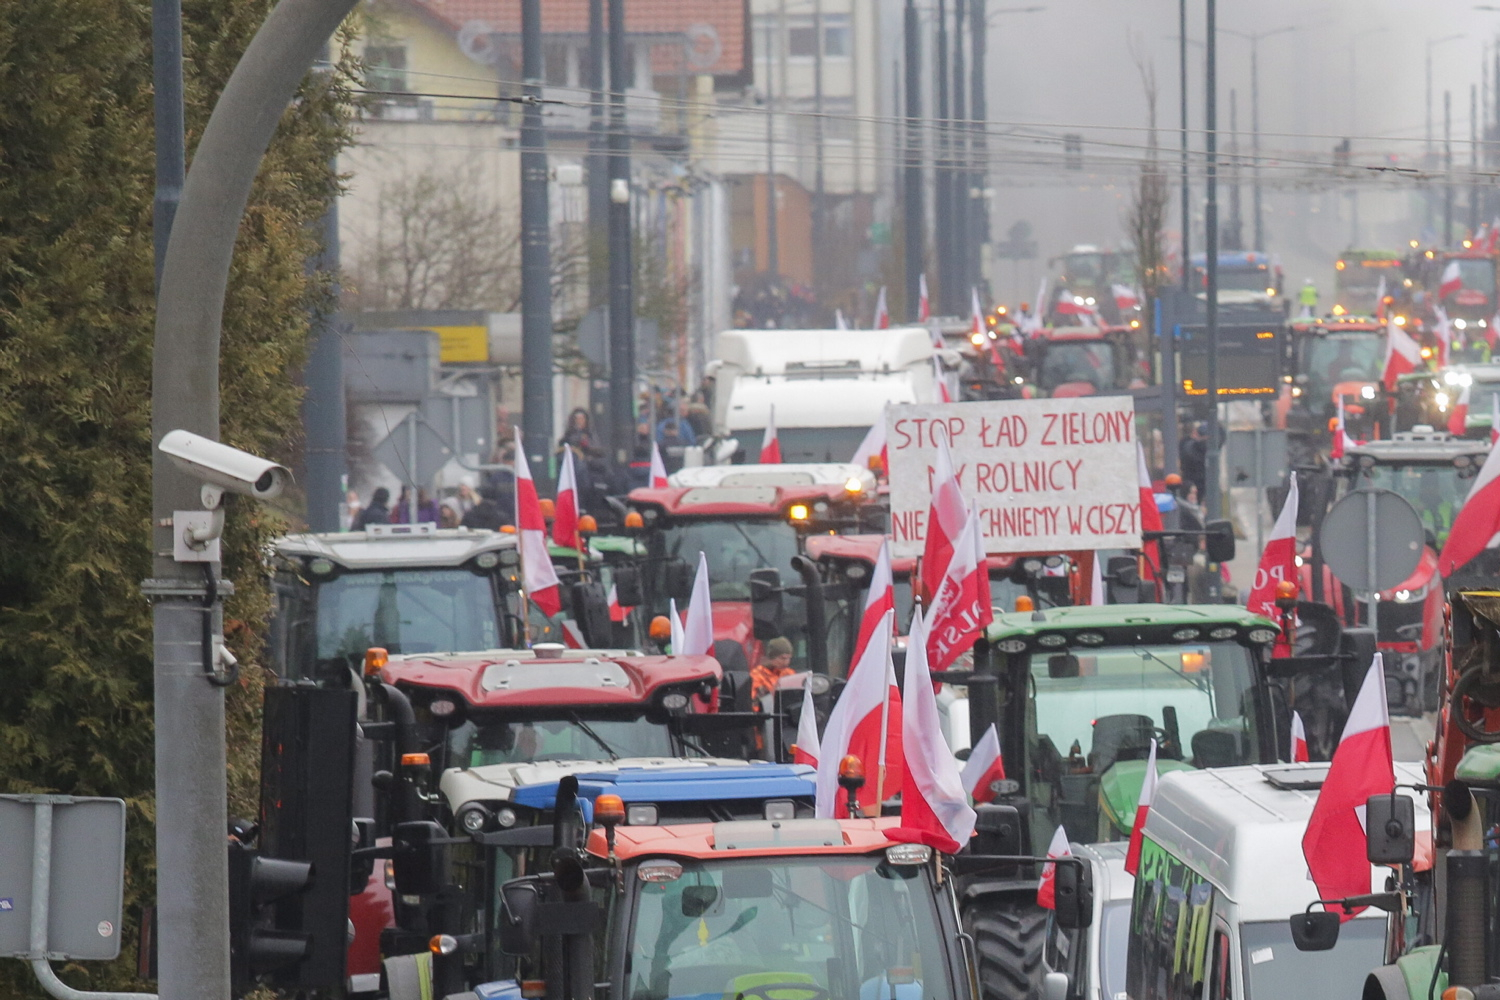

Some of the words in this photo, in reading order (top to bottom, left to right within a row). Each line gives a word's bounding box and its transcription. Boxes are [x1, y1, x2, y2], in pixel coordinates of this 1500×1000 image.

[895, 417, 965, 450] STOP
[978, 415, 1028, 448] ŁAD
[1040, 410, 1134, 446] ZIELONY
[976, 459, 1083, 493] ROLNICY
[892, 510, 925, 542] NIE
[968, 506, 1060, 538] CHNIEMY
[1067, 505, 1083, 535] W
[1087, 502, 1141, 535] CISZY
